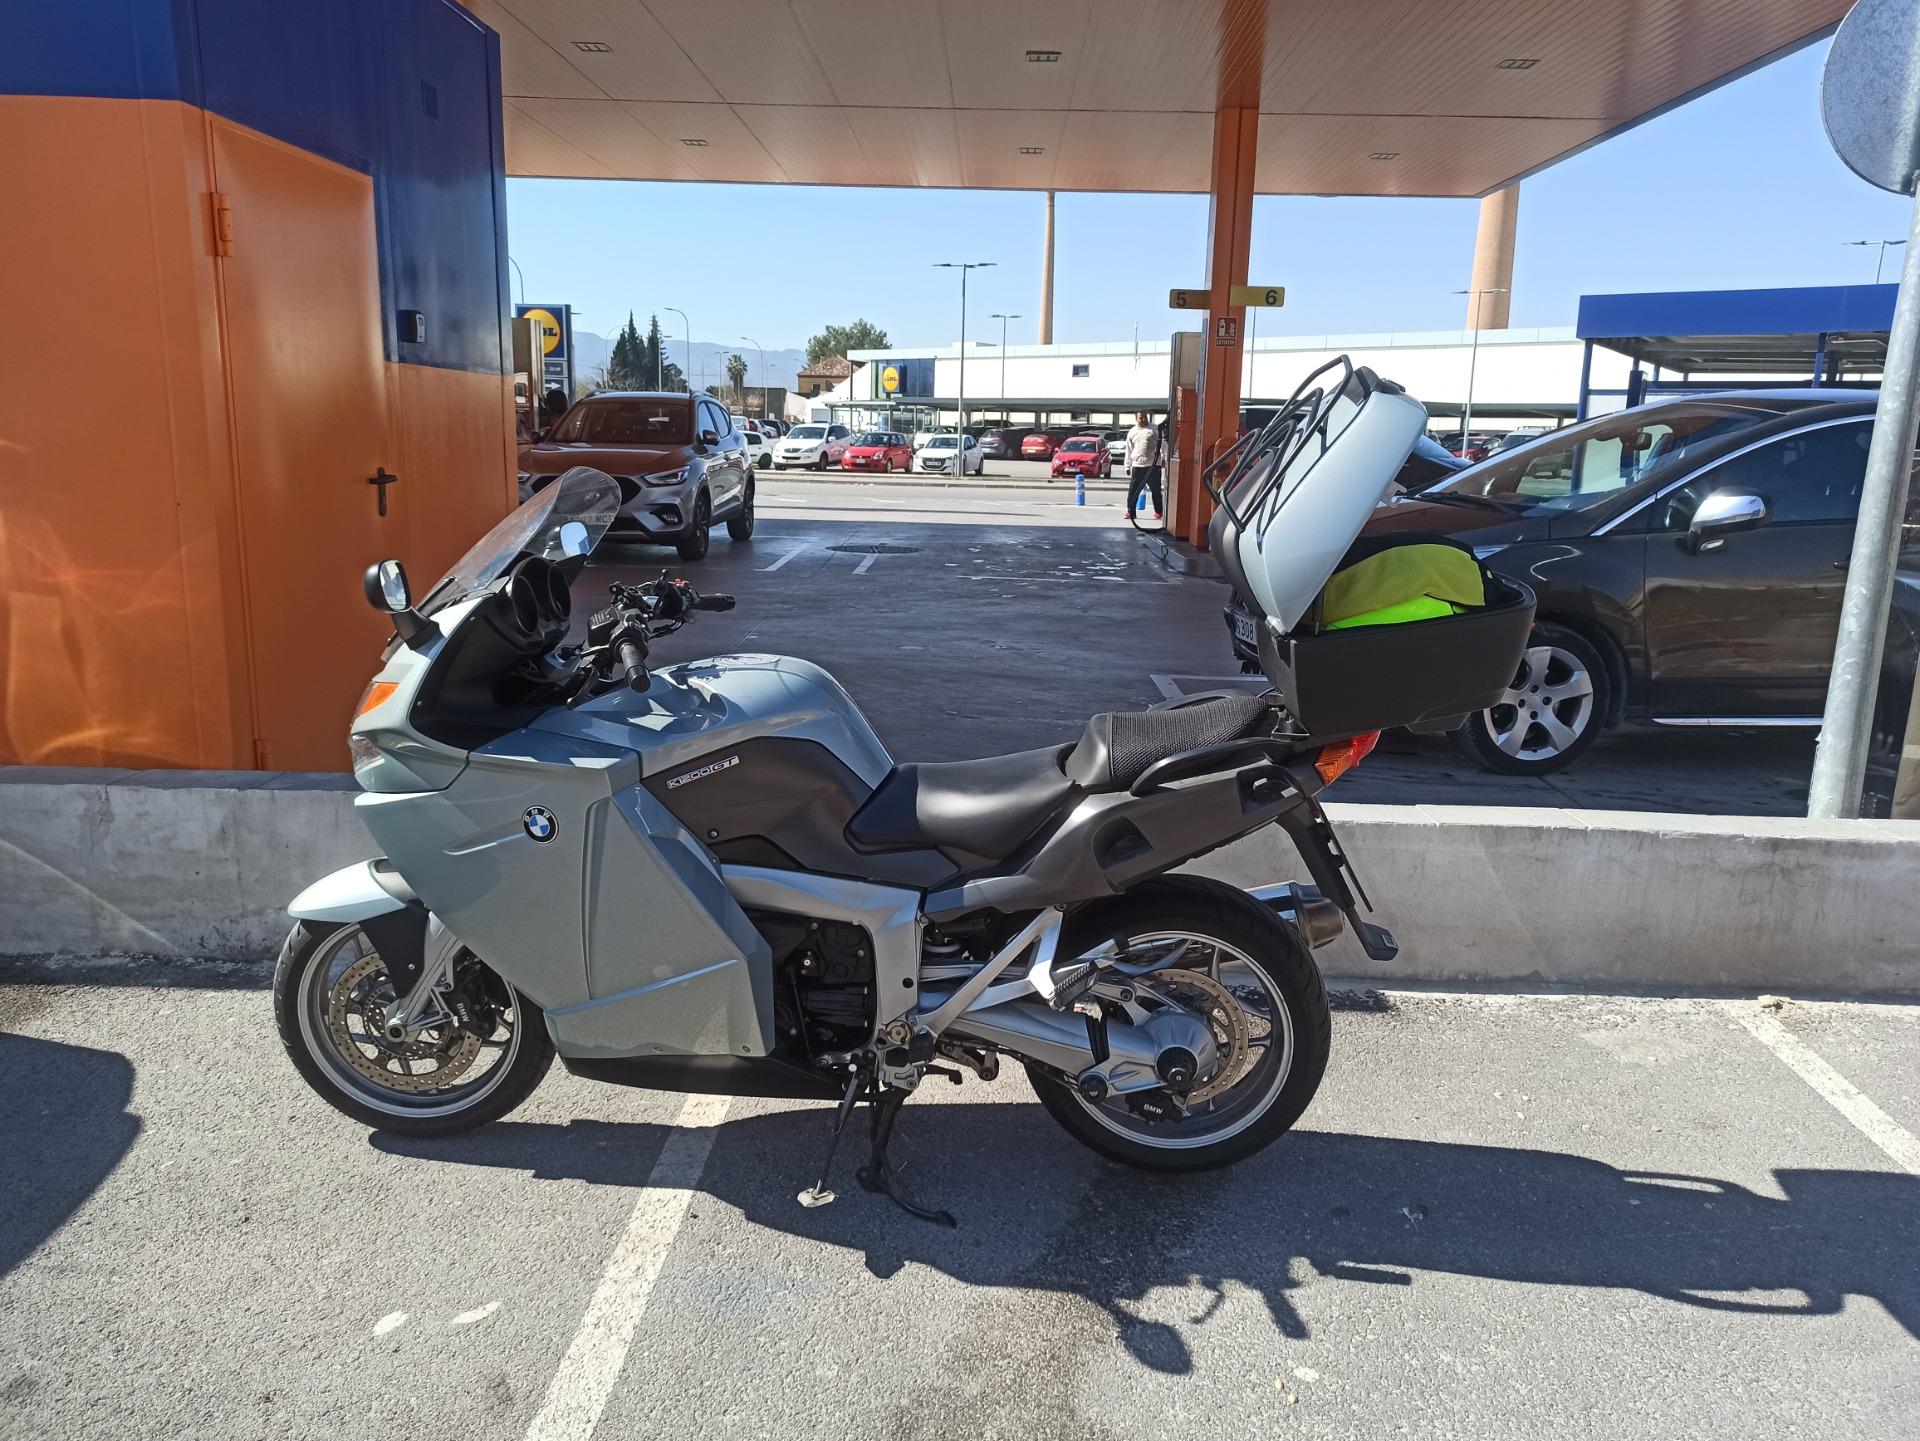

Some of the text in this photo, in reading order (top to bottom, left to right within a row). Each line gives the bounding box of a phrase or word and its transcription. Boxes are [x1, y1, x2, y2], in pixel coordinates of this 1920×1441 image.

[1176, 292, 1187, 308] 5
[1265, 289, 1278, 306] 6
[667, 756, 740, 789] K1200GT
[524, 808, 551, 822] BMW
[456, 1002, 470, 1022] BMW
[1143, 1103, 1164, 1115] BMW
